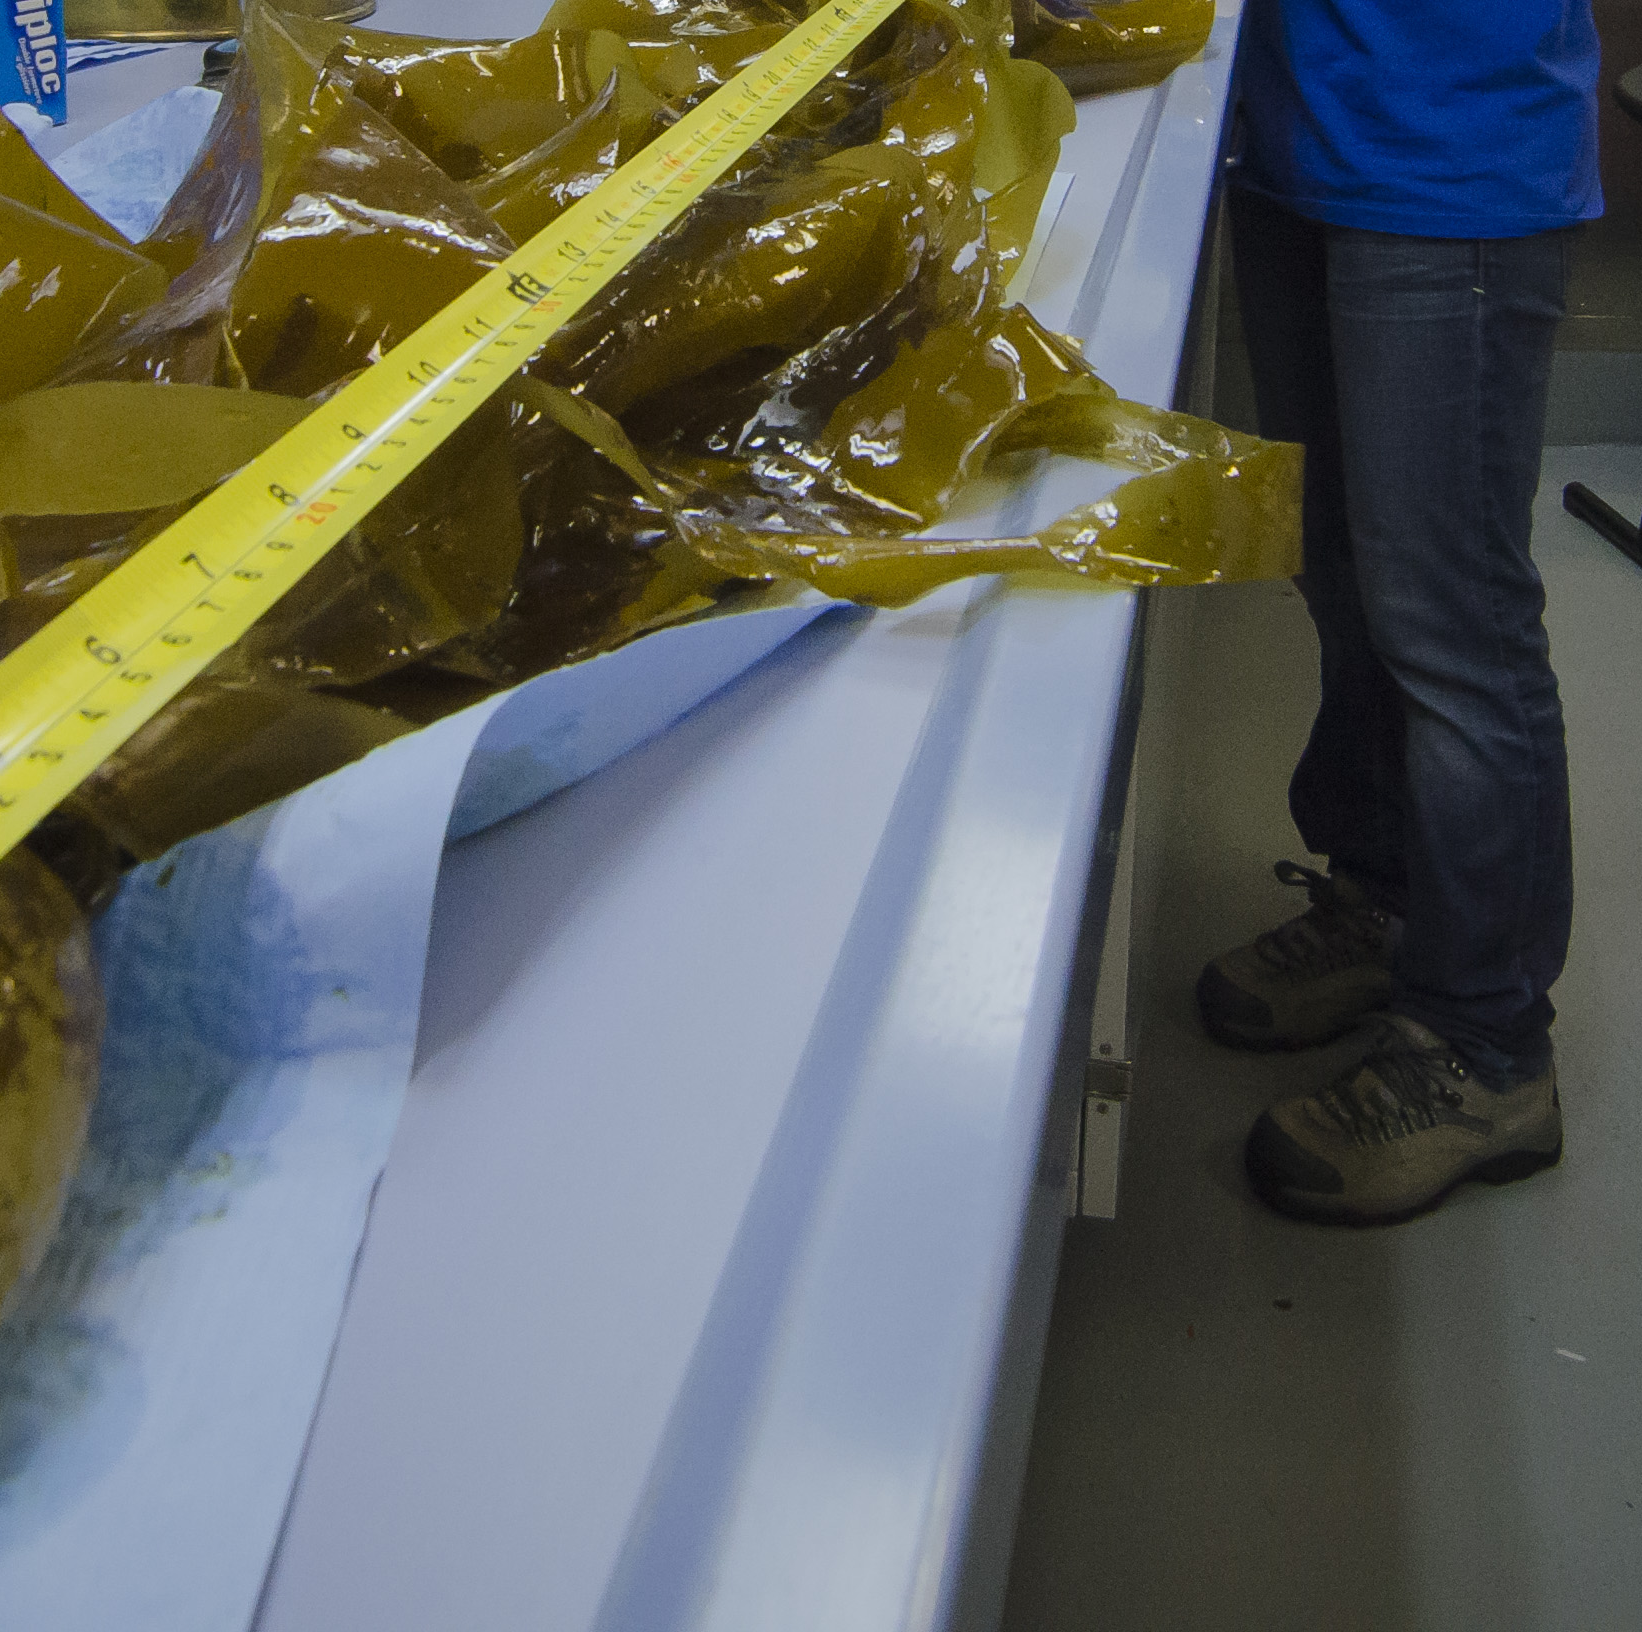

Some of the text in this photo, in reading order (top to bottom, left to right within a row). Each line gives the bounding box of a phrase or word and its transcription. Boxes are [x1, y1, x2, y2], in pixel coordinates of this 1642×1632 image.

[84, 635, 123, 665] 6
[180, 553, 216, 580] 7
[268, 482, 301, 508] 8
[341, 423, 369, 441] 9
[406, 361, 445, 387] 10
[463, 317, 496, 340] 11
[558, 241, 587, 263] 13
[596, 209, 625, 229] 14
[762, 71, 782, 86] 20
[120, 669, 154, 686] 5
[161, 632, 193, 649] 6
[197, 598, 225, 612] 7
[233, 568, 264, 581] 8
[295, 501, 338, 526] 20
